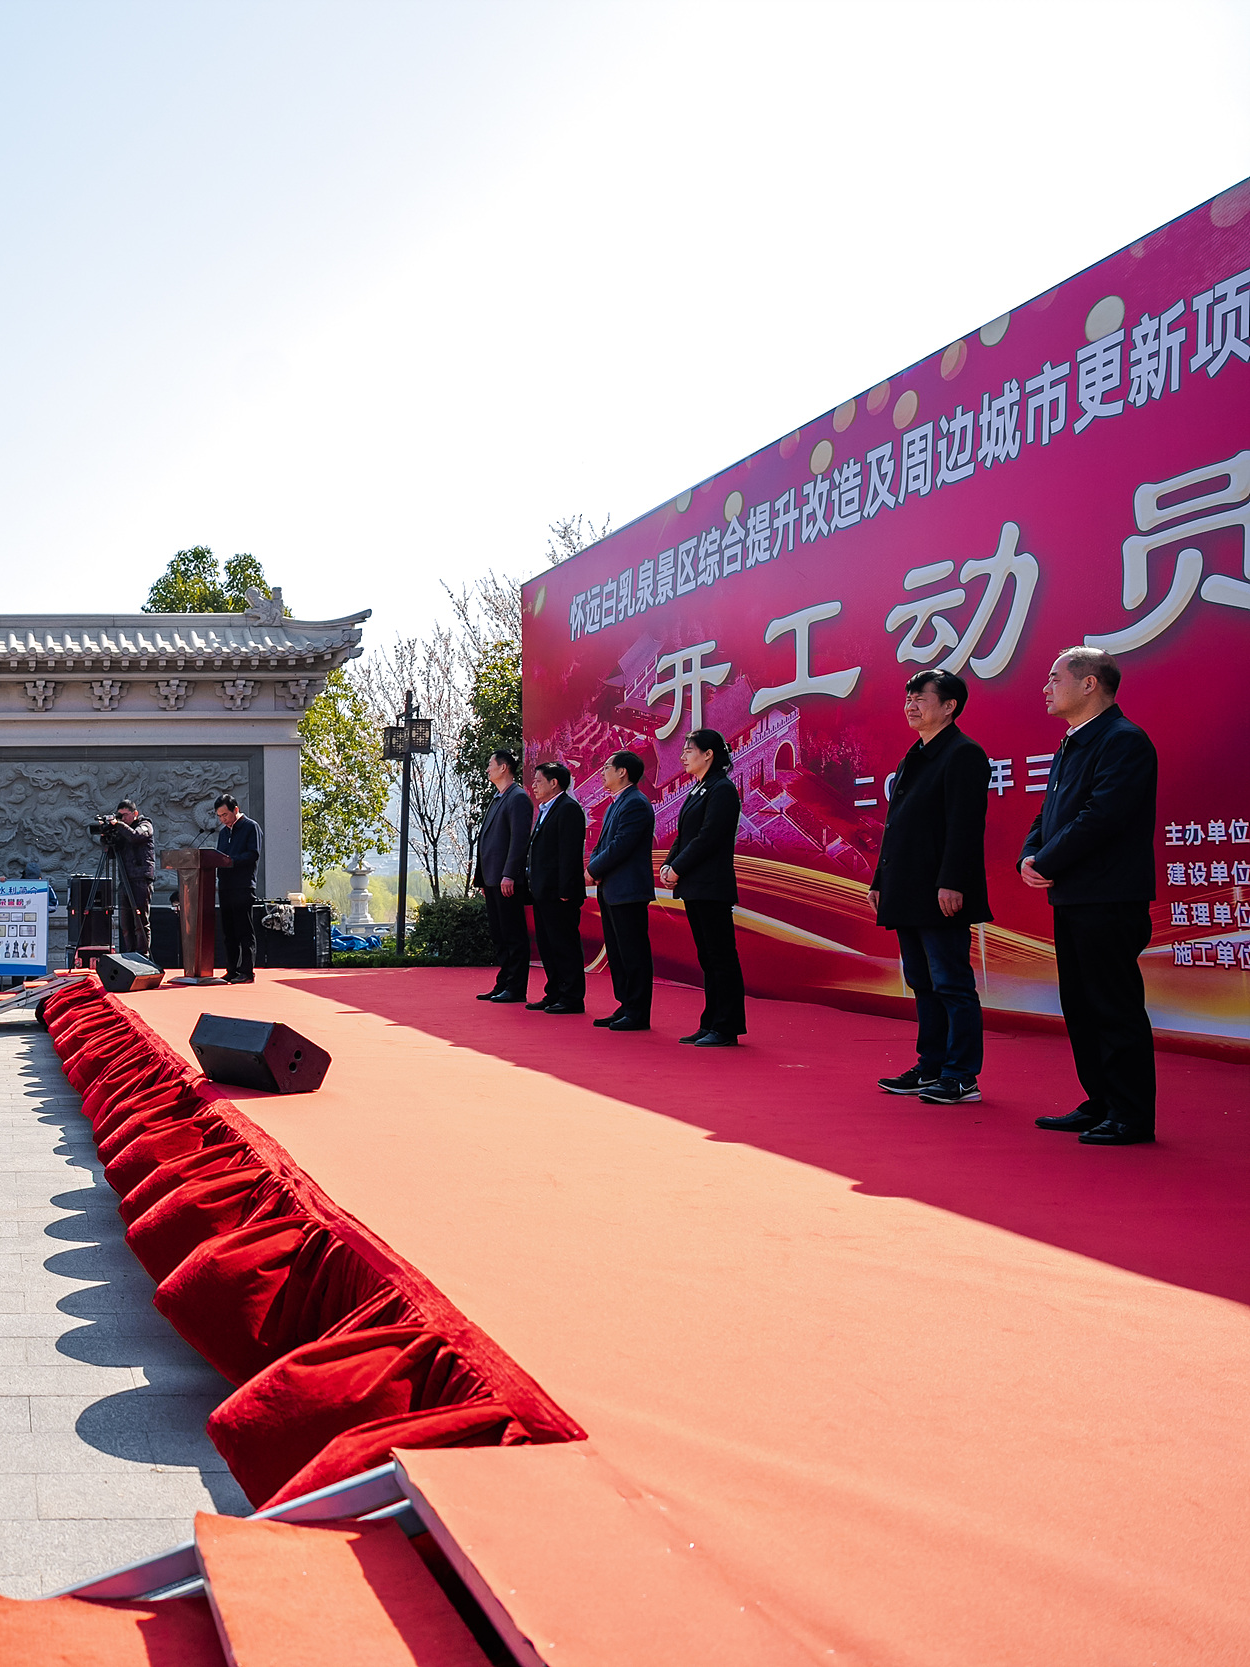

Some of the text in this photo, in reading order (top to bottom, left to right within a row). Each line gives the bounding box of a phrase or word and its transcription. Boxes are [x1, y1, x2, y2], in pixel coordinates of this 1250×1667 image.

[569, 268, 1250, 642] 怀远白乳泉景区综合提升改造及周边城市更新项
[646, 449, 1250, 741] 开工动员
[1165, 818, 1250, 846] 主办单位
[1166, 860, 1250, 887] 建设单位
[1170, 901, 1250, 928] 监理单位
[1172, 941, 1250, 970] 施工单位
